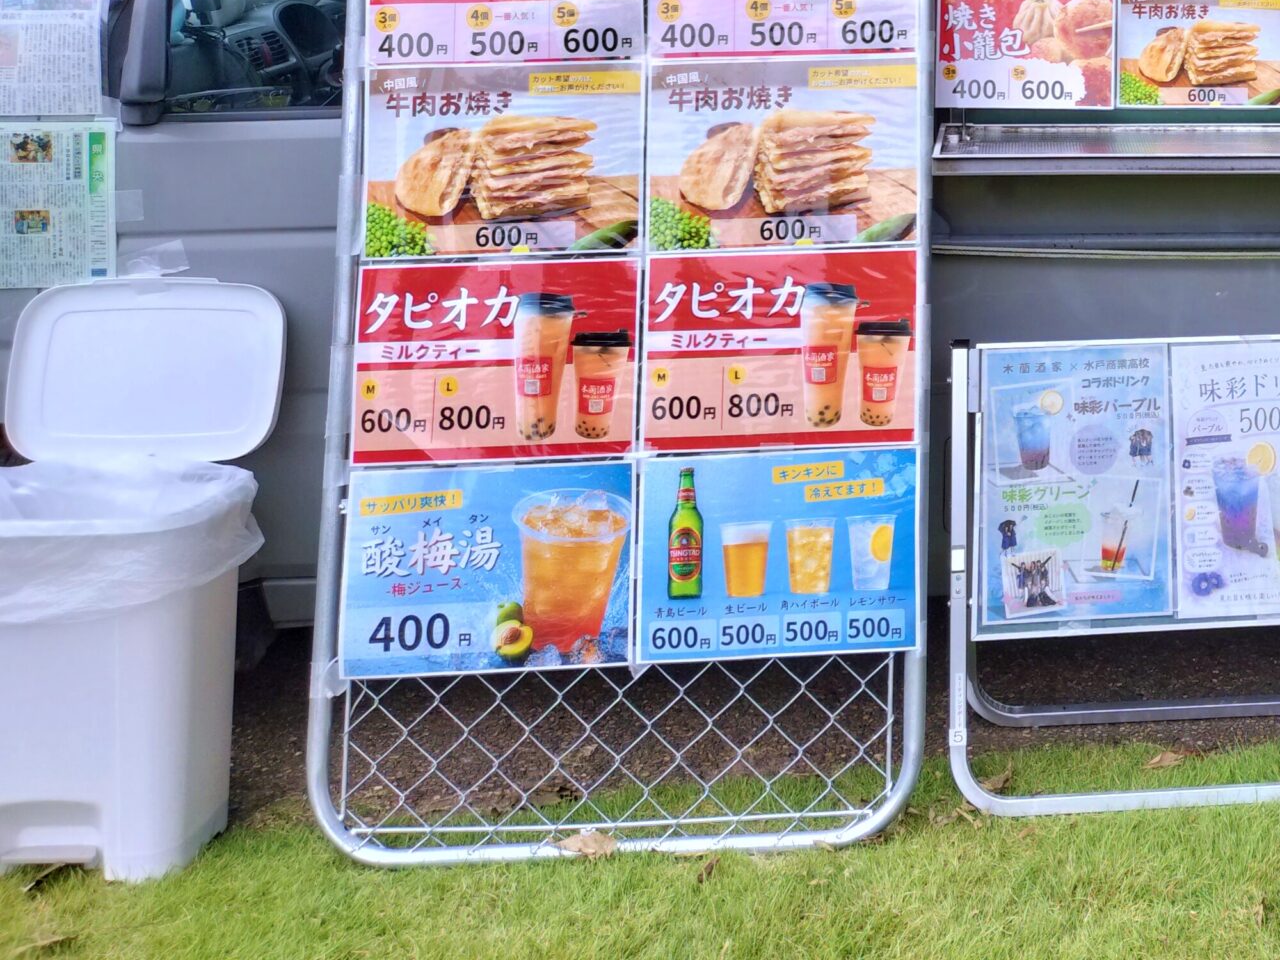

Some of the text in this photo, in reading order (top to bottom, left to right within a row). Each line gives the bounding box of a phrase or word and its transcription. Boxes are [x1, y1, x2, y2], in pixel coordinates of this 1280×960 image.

[471, 9, 489, 22] 4個
[750, 0, 768, 13] 4個
[944, 1, 997, 32] 焼き
[1132, 4, 1209, 20] 牛肉お焼き
[378, 27, 633, 58] 400円 500円 600円
[661, 19, 907, 48] 400円 500円 600円
[943, 27, 1031, 60] 小籠包
[383, 76, 418, 90] 中国風
[666, 71, 700, 86] 中国風
[668, 86, 793, 112] 牛肉お焼き
[952, 79, 1072, 100] 400円 600円
[1188, 88, 1226, 102] 600円
[386, 91, 513, 117] 牛肉お焼き
[475, 226, 538, 247] 600円
[760, 219, 822, 241] 600円
[364, 286, 520, 334] タピオカ
[654, 276, 806, 323] タピオカ
[671, 333, 767, 349] ミルクティー
[381, 344, 481, 360] ミルクティー
[657, 371, 741, 382] M L
[1081, 376, 1150, 389] コラボドリンク
[366, 382, 452, 394] M L
[651, 392, 793, 420] 600円 800円
[361, 405, 505, 433] 600円 800円
[779, 466, 837, 480] キンキンに
[809, 483, 877, 498] 冷えてます！
[1002, 485, 1090, 503] 味彩グリーン
[365, 494, 457, 514] サッパリ爽快！
[371, 514, 489, 535] サン メイ タン
[361, 527, 503, 577] 酸梅湯
[654, 595, 907, 619] 青島ビール 生ビール 角ハイボール レモンサワー
[652, 616, 902, 650] 600円 500円 500円 500円
